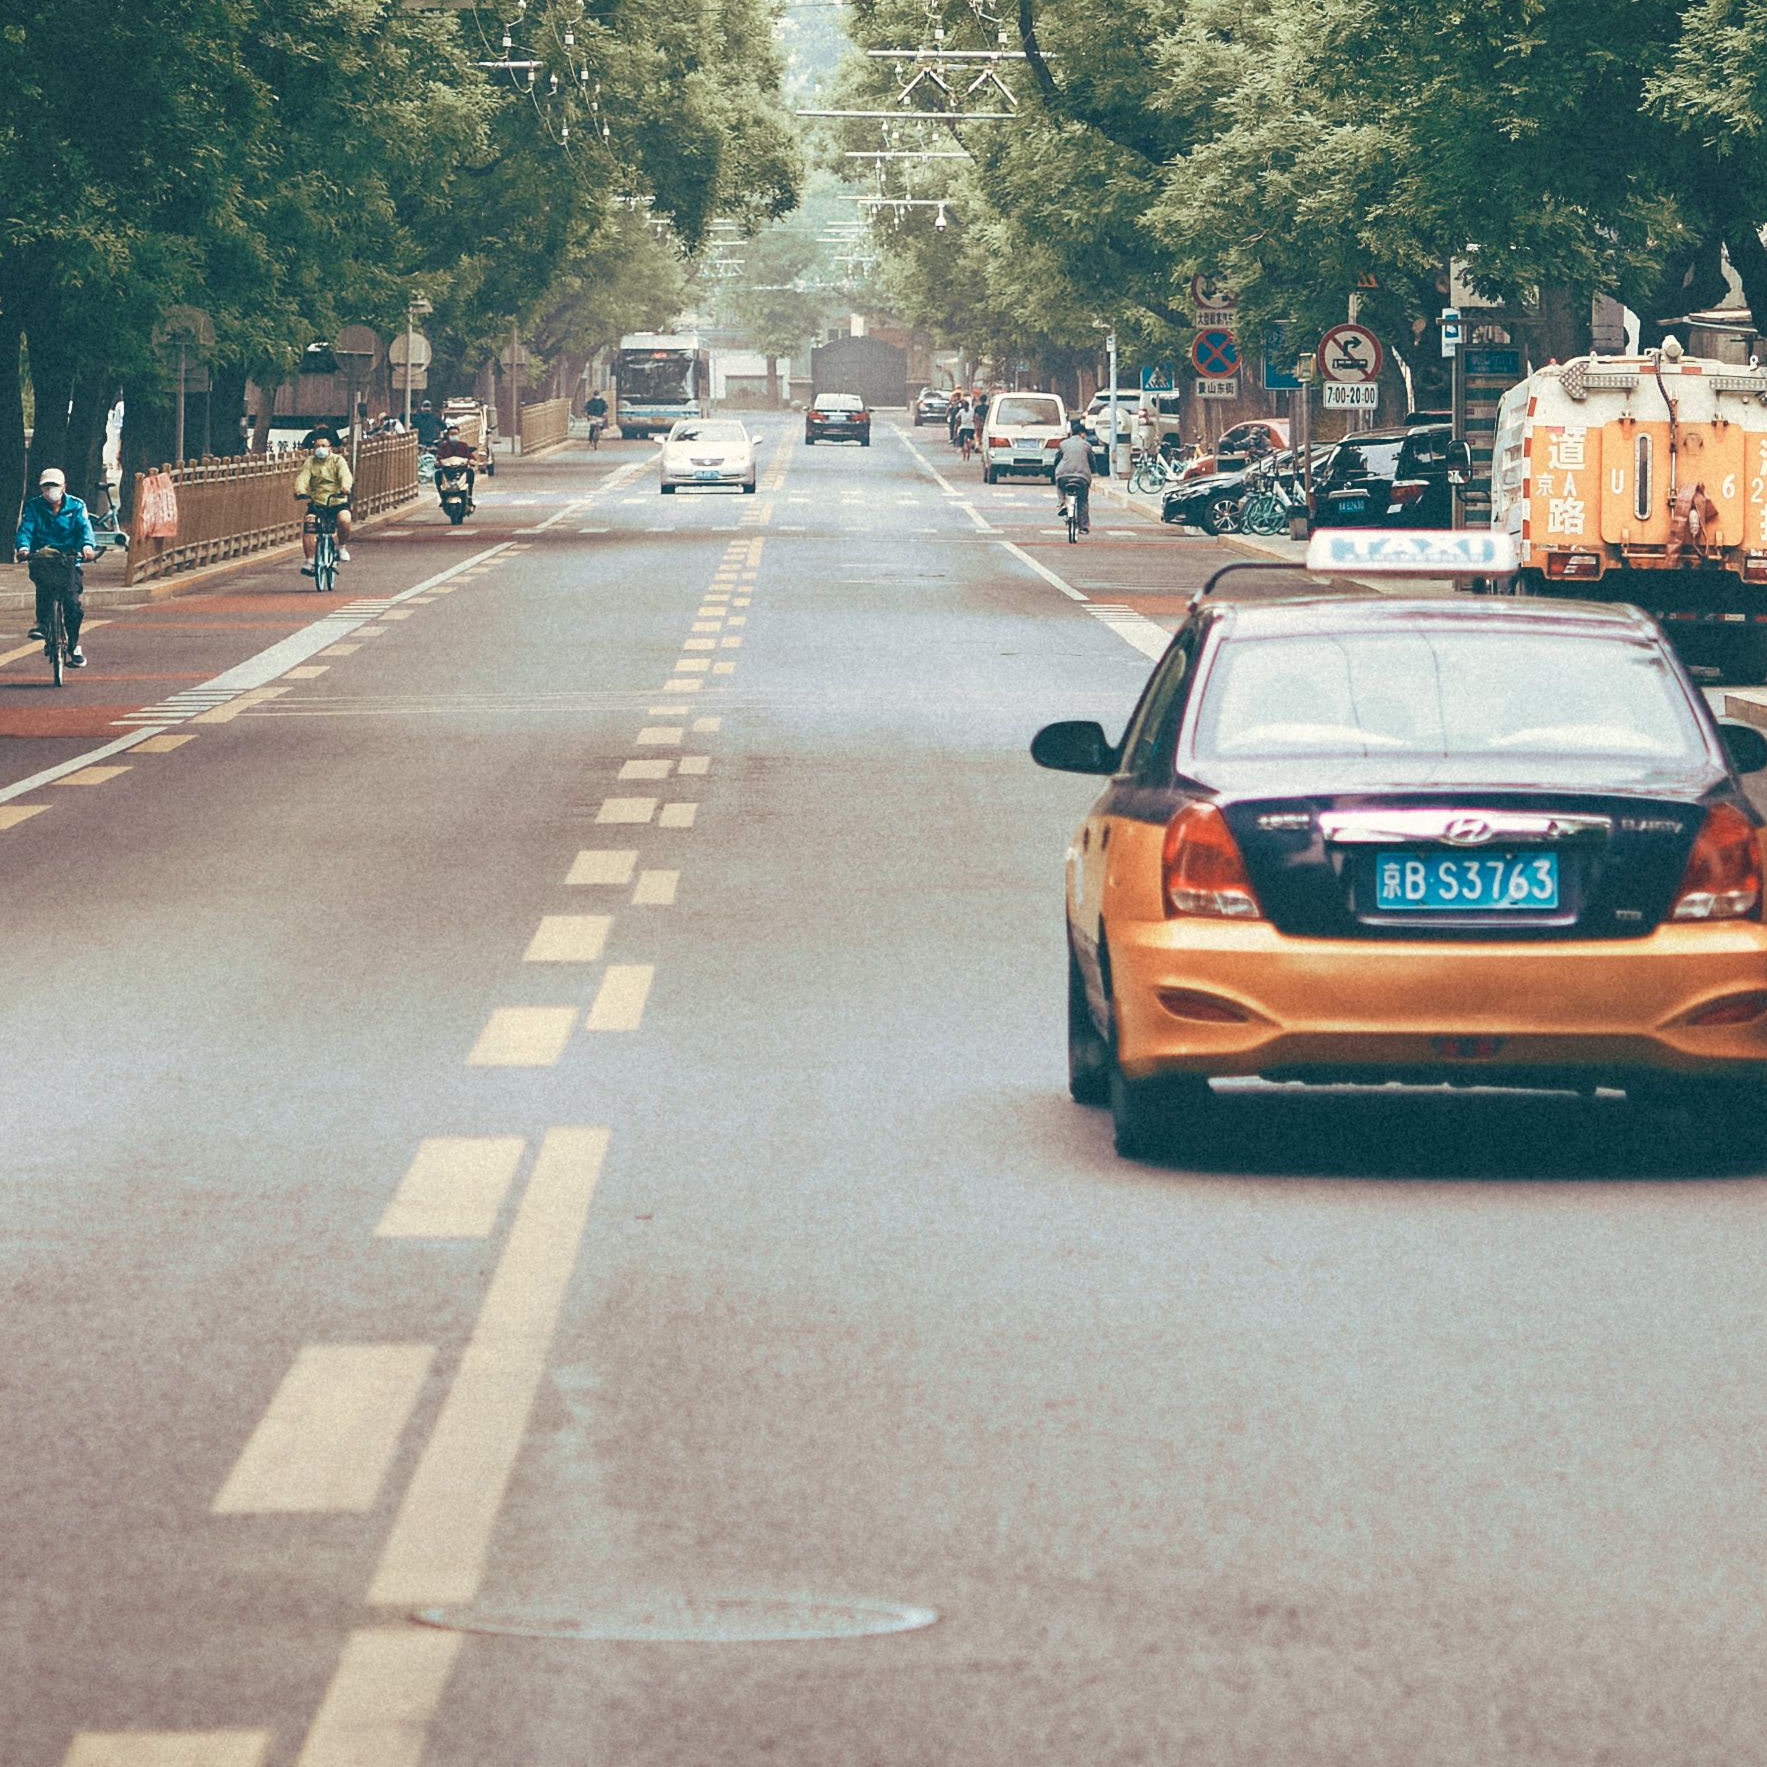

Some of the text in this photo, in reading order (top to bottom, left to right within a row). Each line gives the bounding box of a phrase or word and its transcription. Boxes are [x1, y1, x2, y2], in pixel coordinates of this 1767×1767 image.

[1198, 381, 1234, 394] 景山东街
[1327, 386, 1375, 404] 7:00-20:00
[1340, 536, 1488, 558] TAXI
